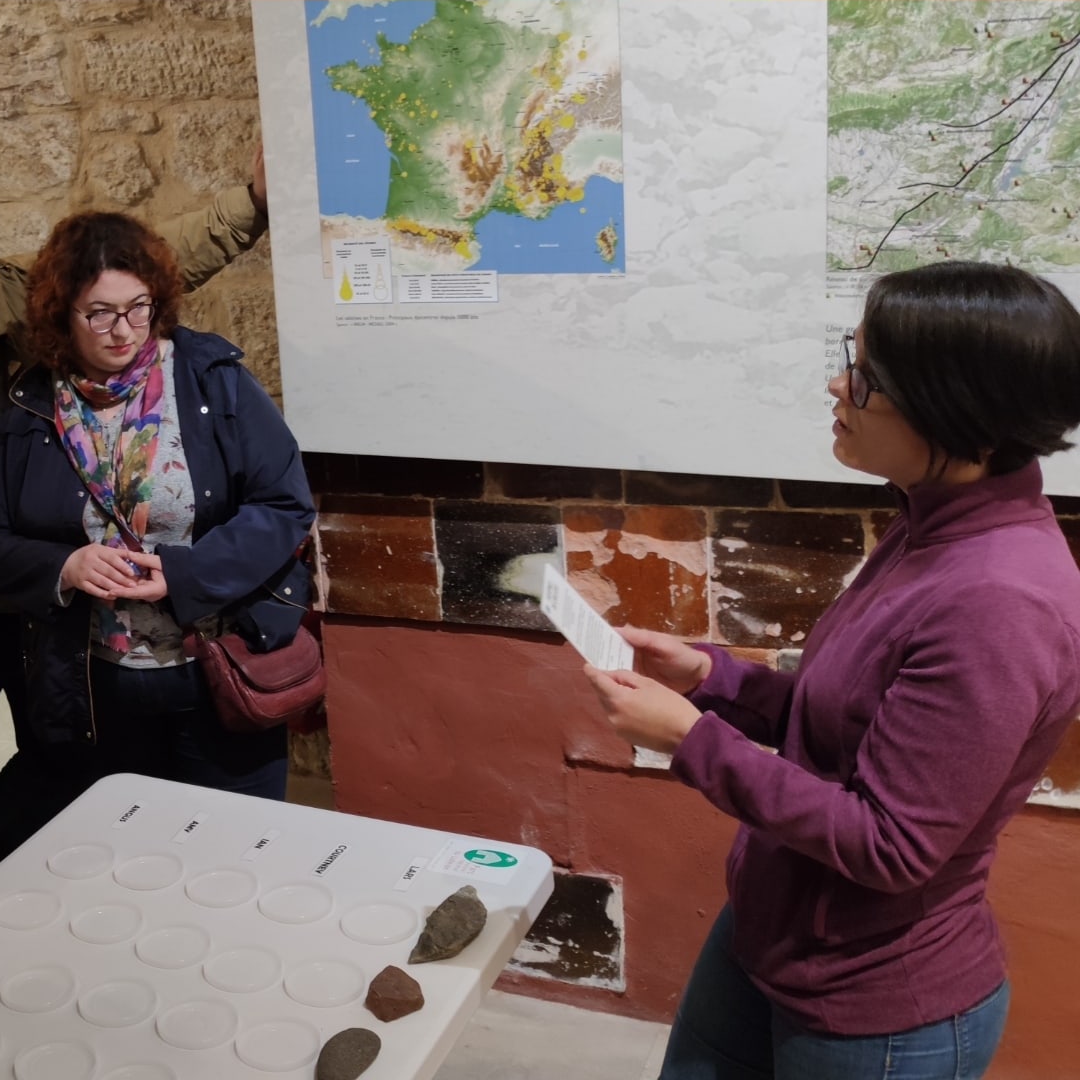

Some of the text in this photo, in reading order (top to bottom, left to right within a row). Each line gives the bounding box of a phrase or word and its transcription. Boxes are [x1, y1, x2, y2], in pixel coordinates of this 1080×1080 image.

[825, 324, 844, 333] Une
[825, 337, 841, 345] bor
[825, 362, 835, 370] de
[824, 399, 832, 407] et
[119, 804, 141, 822] ANGUS
[253, 838, 270, 850] IAN
[315, 844, 347, 875] COURTNEY
[402, 865, 420, 880] LARS
